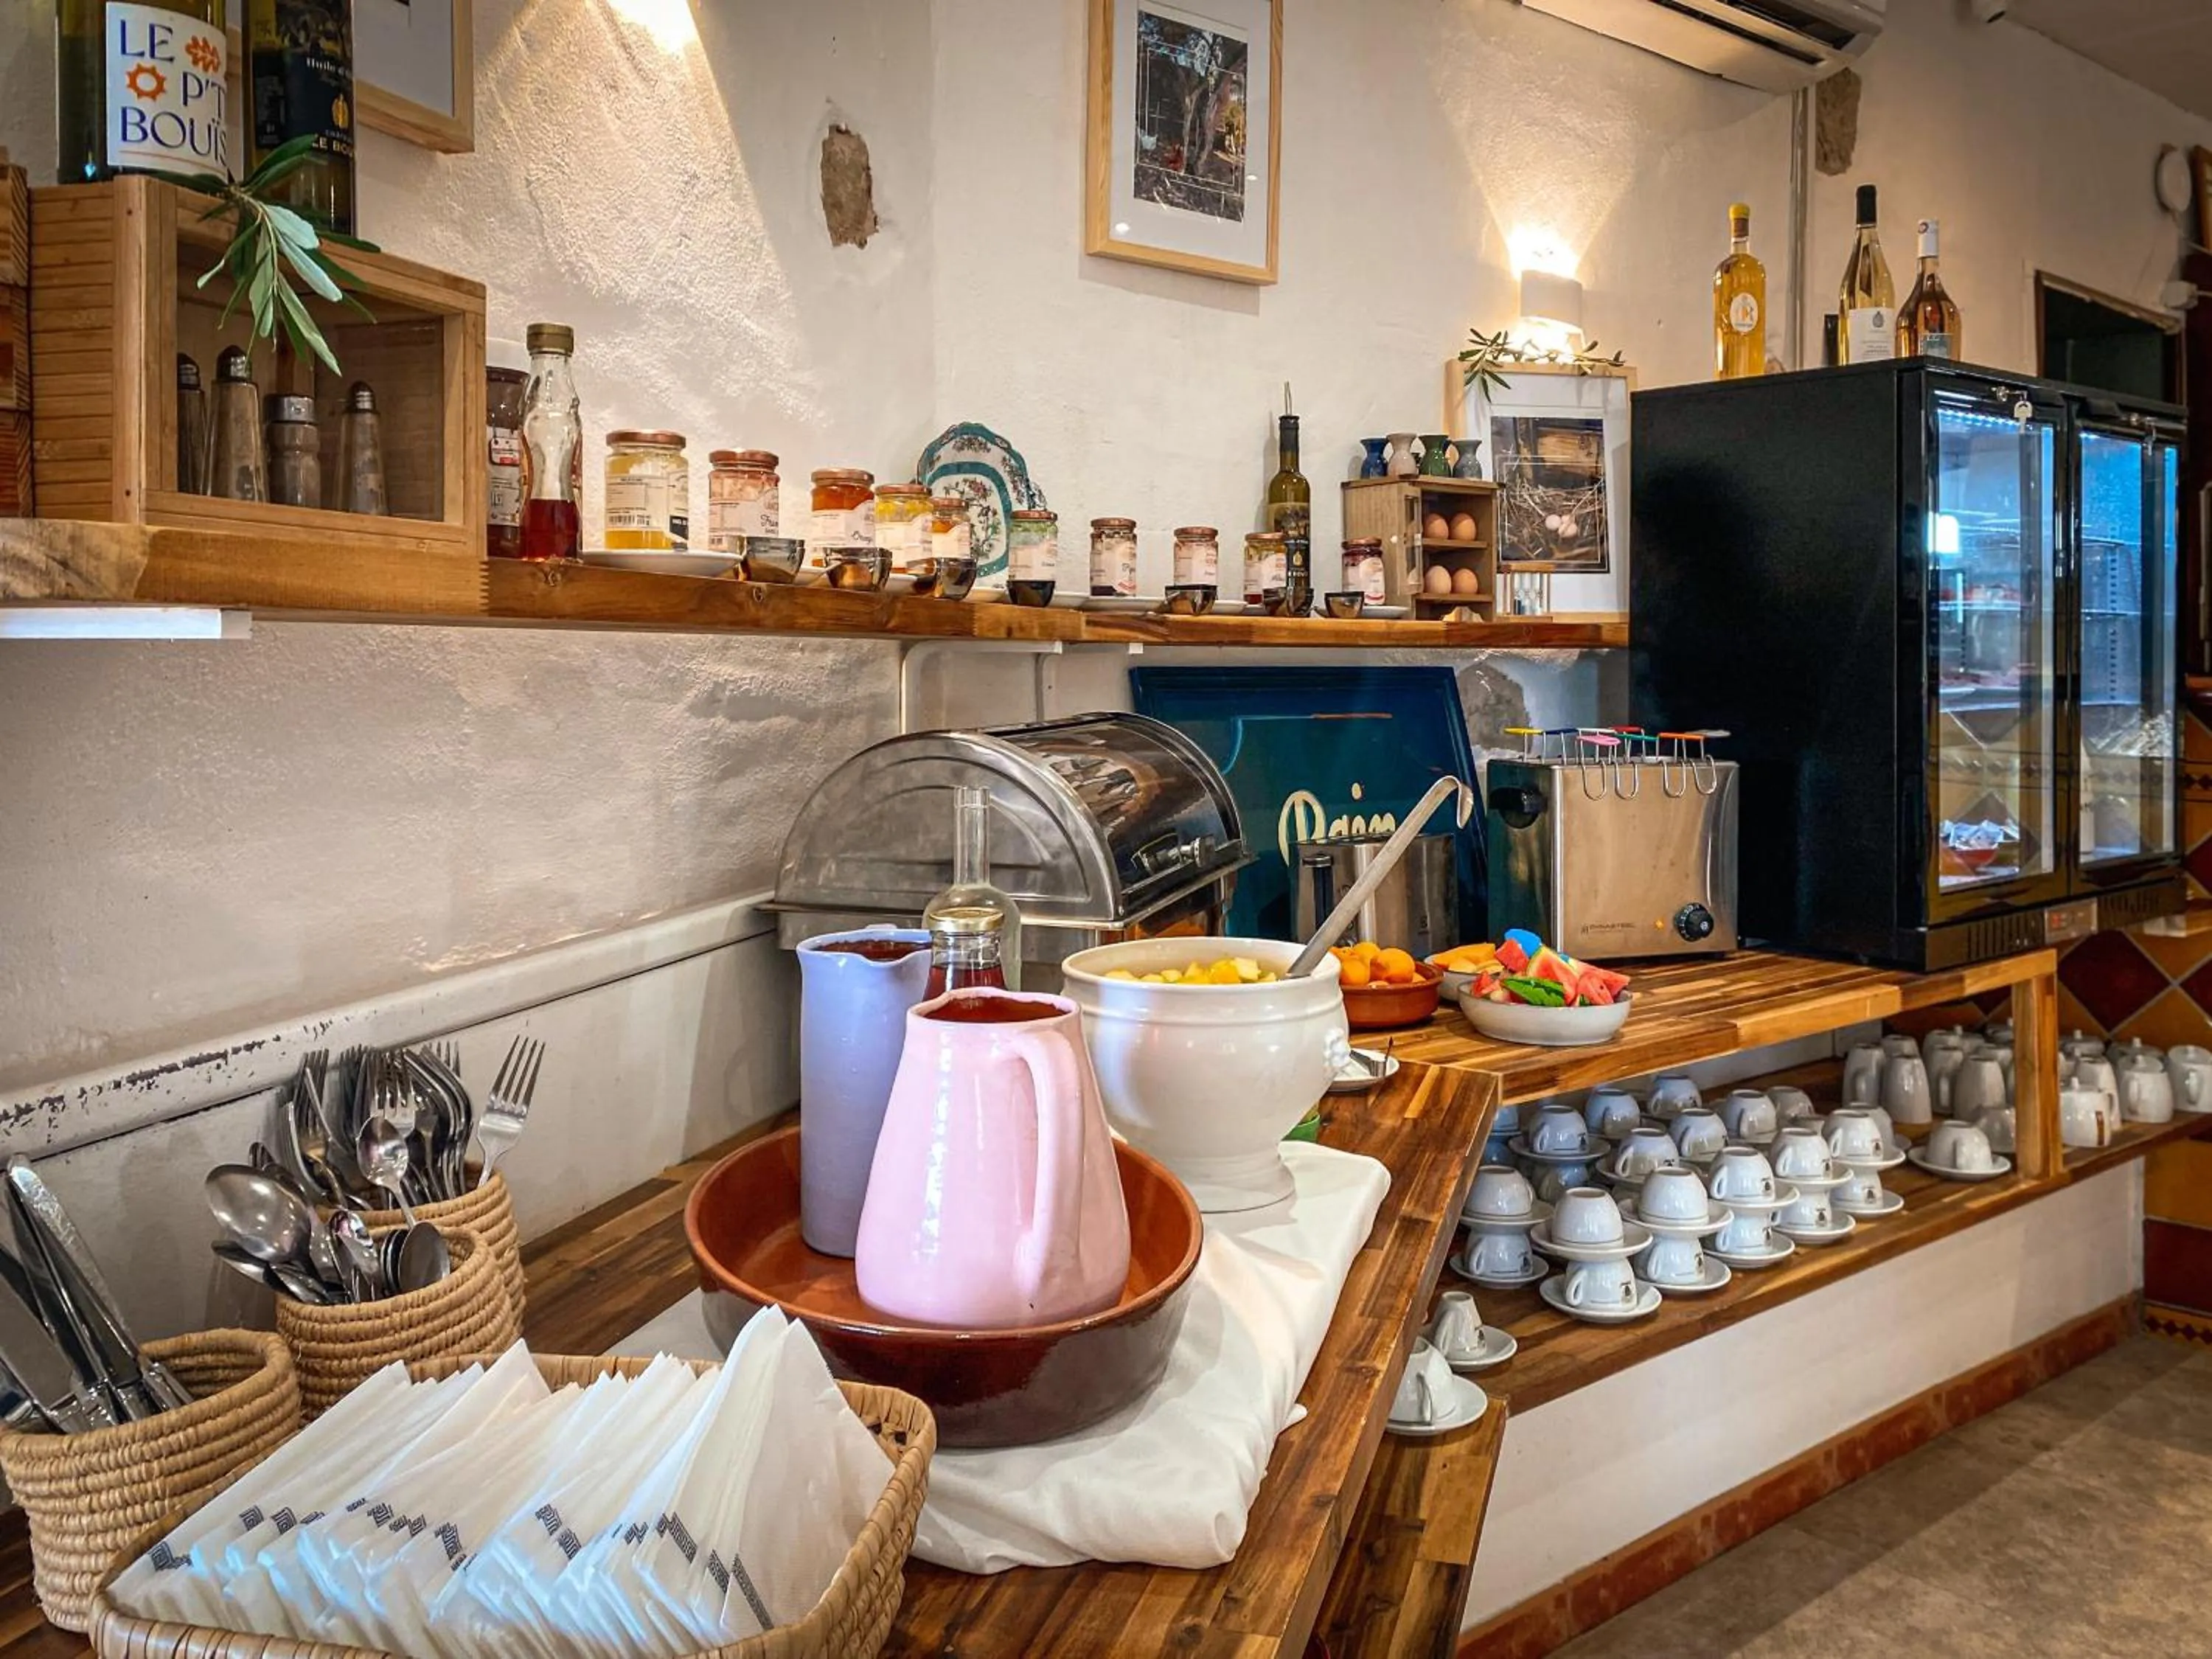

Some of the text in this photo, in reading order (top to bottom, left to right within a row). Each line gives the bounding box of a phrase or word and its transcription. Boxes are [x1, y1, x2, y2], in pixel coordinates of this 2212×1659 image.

[120, 19, 175, 63] LE
[182, 71, 226, 119] P'T
[312, 133, 328, 148] E
